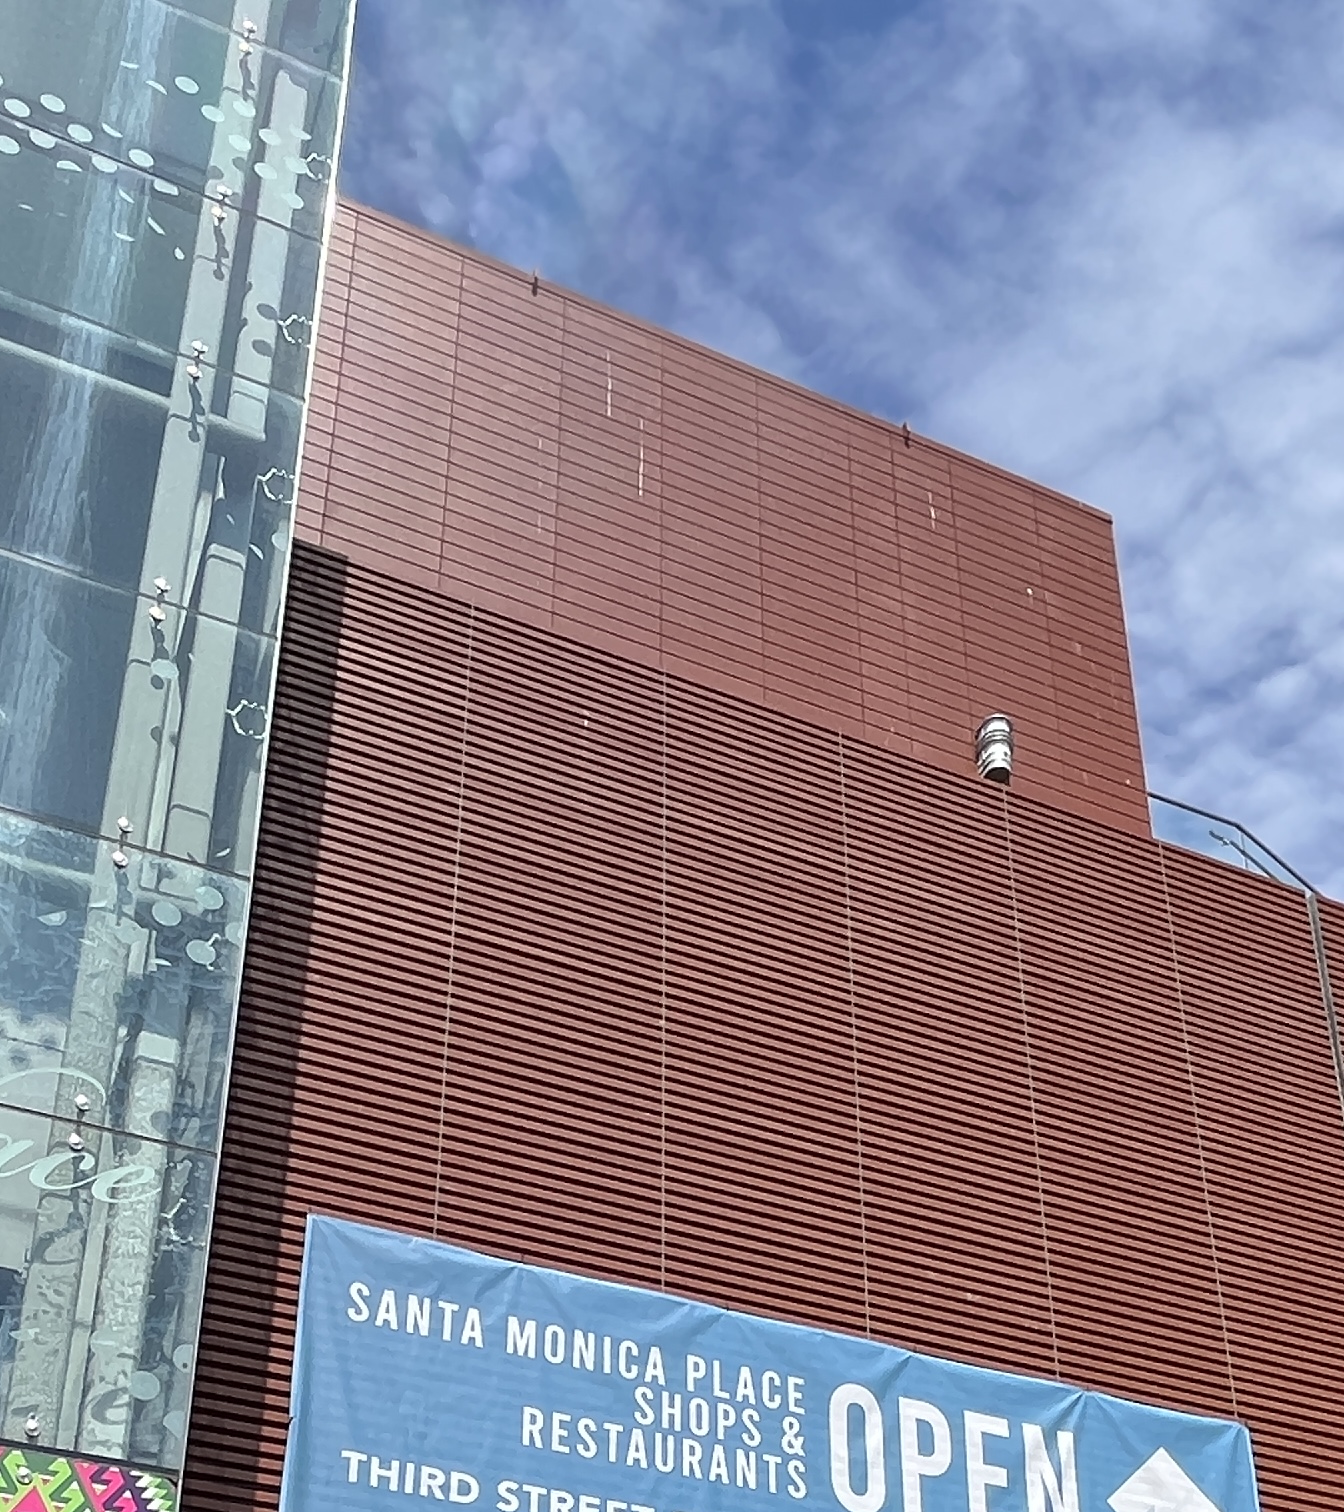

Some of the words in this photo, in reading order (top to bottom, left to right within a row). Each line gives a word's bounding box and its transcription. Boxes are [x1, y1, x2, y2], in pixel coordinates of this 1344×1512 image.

[347, 1281, 484, 1349] SANTA
[506, 1315, 666, 1387] MONICA
[686, 1354, 806, 1416] PLACE
[522, 1406, 808, 1500] RESTAURANTS
[633, 1386, 761, 1448] SHOPS
[781, 1415, 806, 1457] &
[341, 1449, 480, 1505] THIRD
